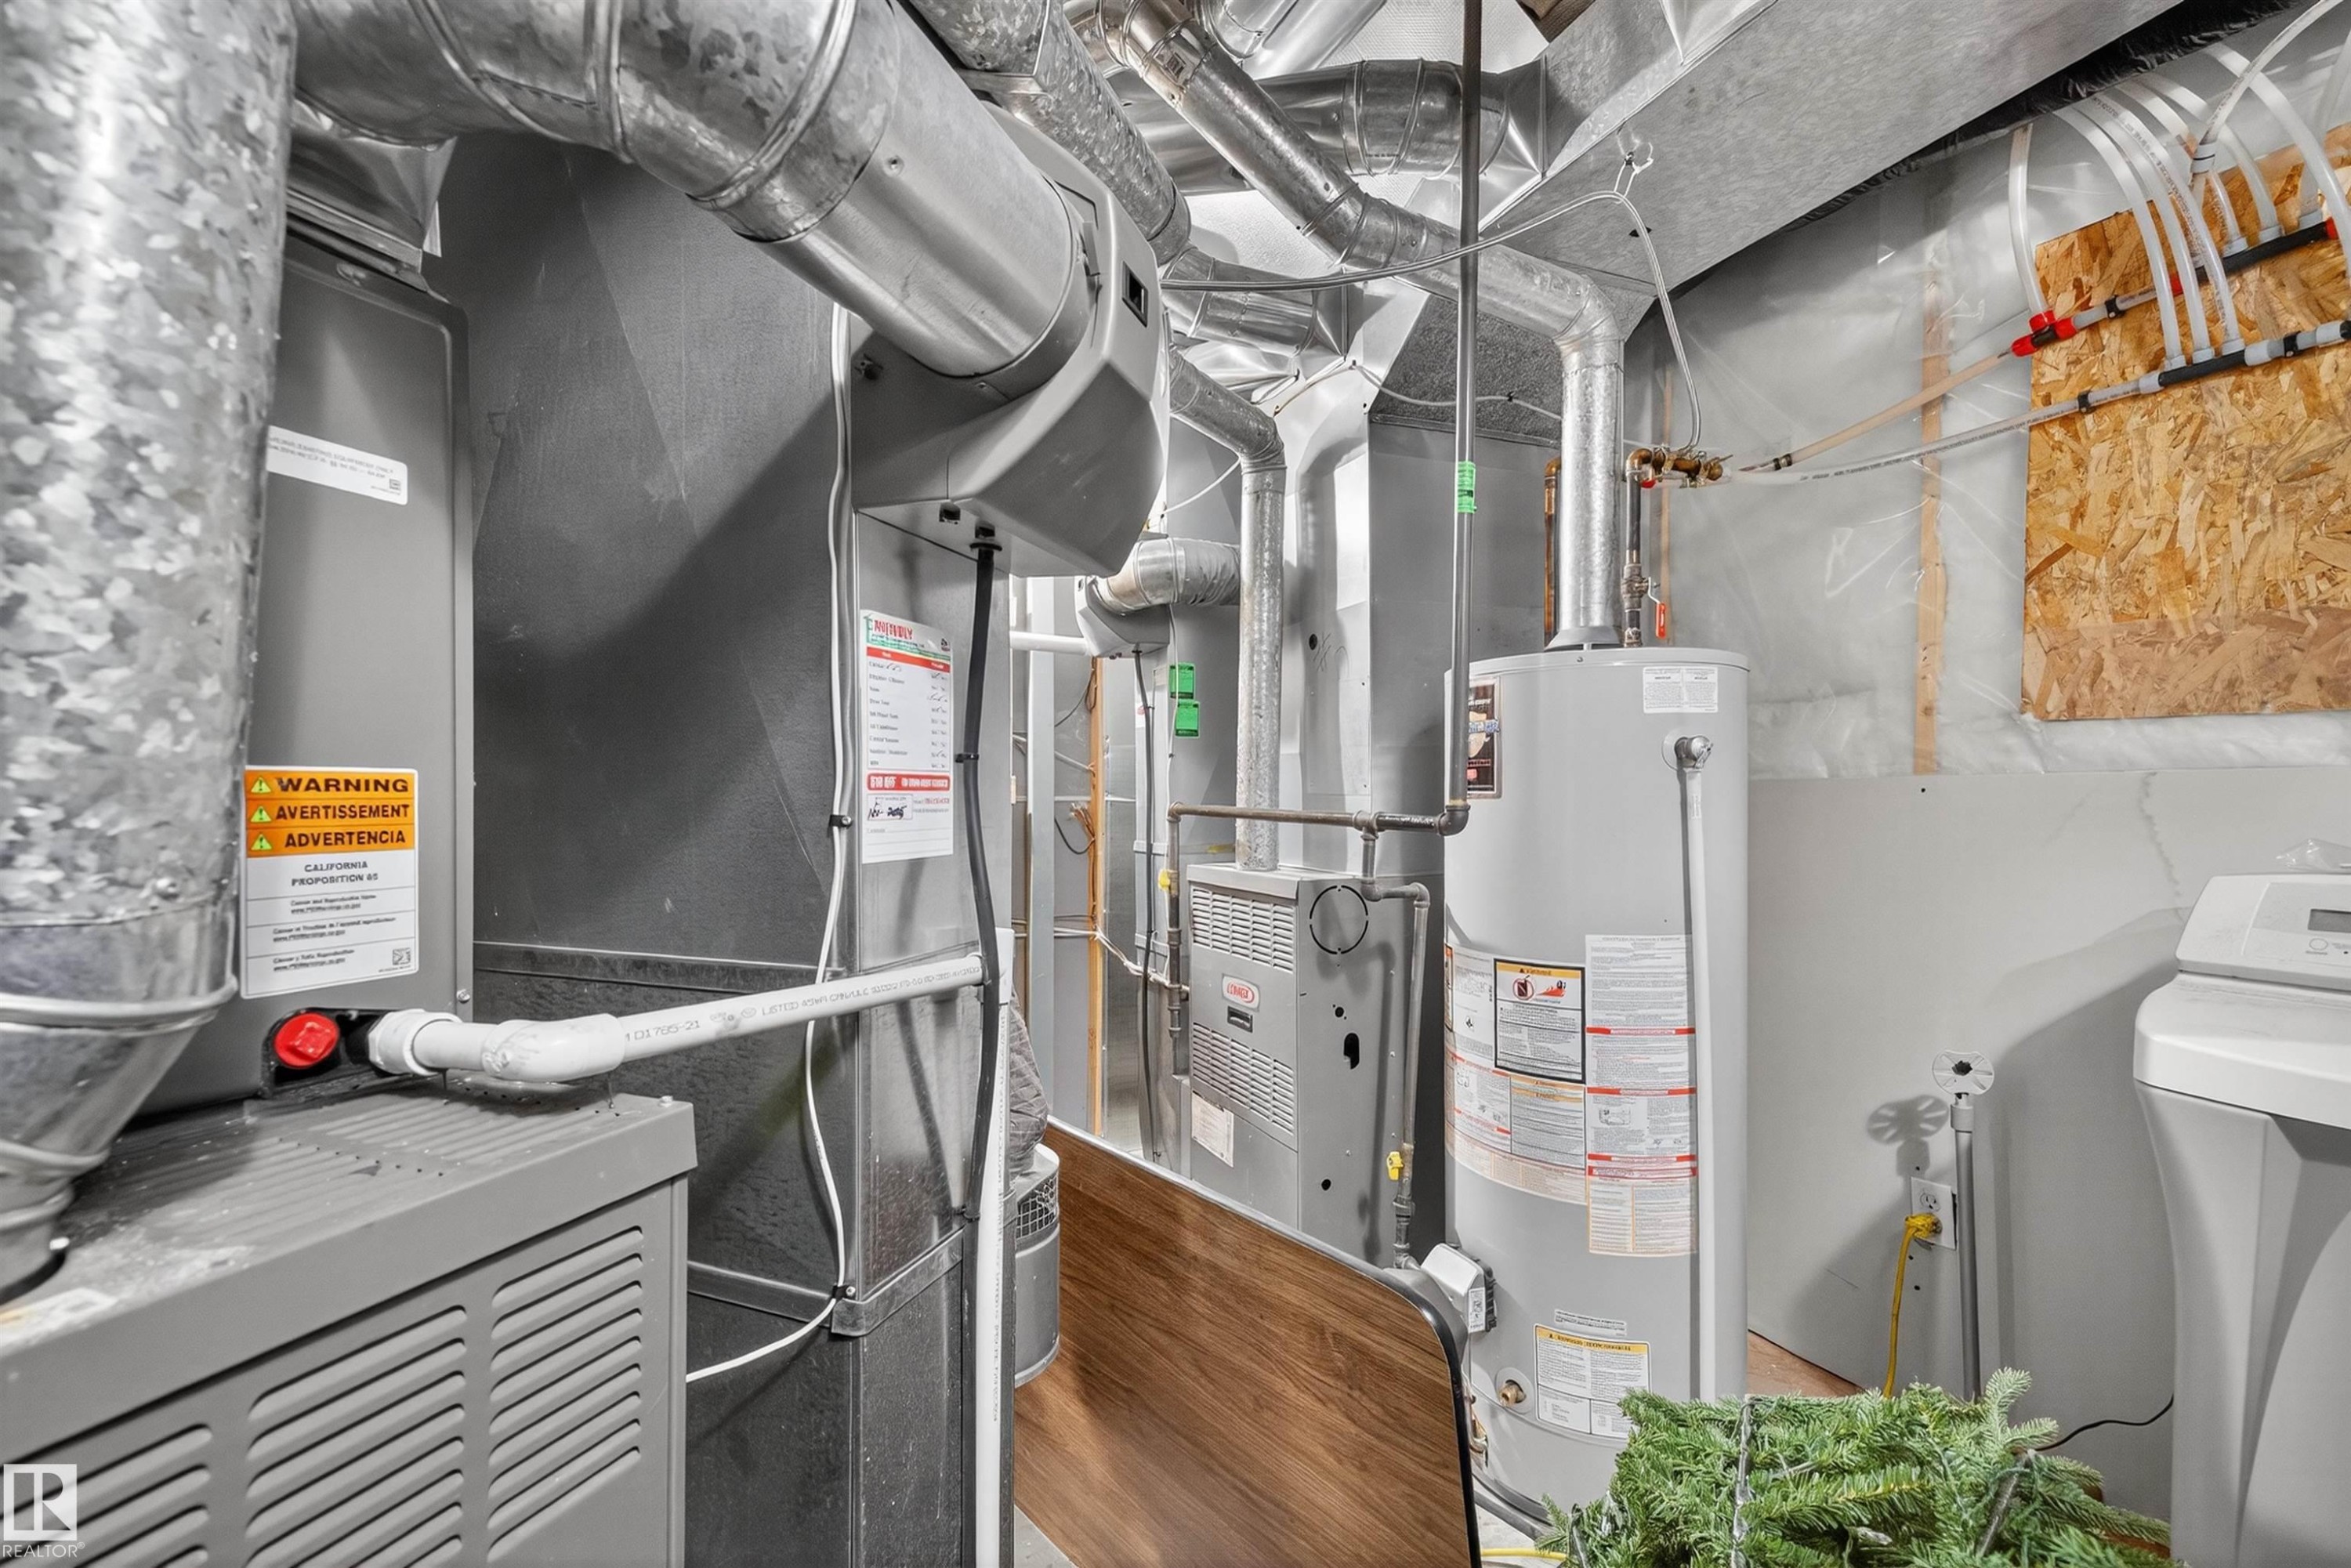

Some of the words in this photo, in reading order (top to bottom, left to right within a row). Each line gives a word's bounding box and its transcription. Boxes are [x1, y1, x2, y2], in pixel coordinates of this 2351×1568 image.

[277, 778, 408, 792] WARNING
[276, 805, 410, 820] AVERTISSEMENT
[285, 831, 405, 848] ADVERTENCIA
[304, 861, 368, 872] CALIFORNIA
[292, 874, 364, 886] PROPOSITION
[762, 1001, 799, 1016] LISTED
